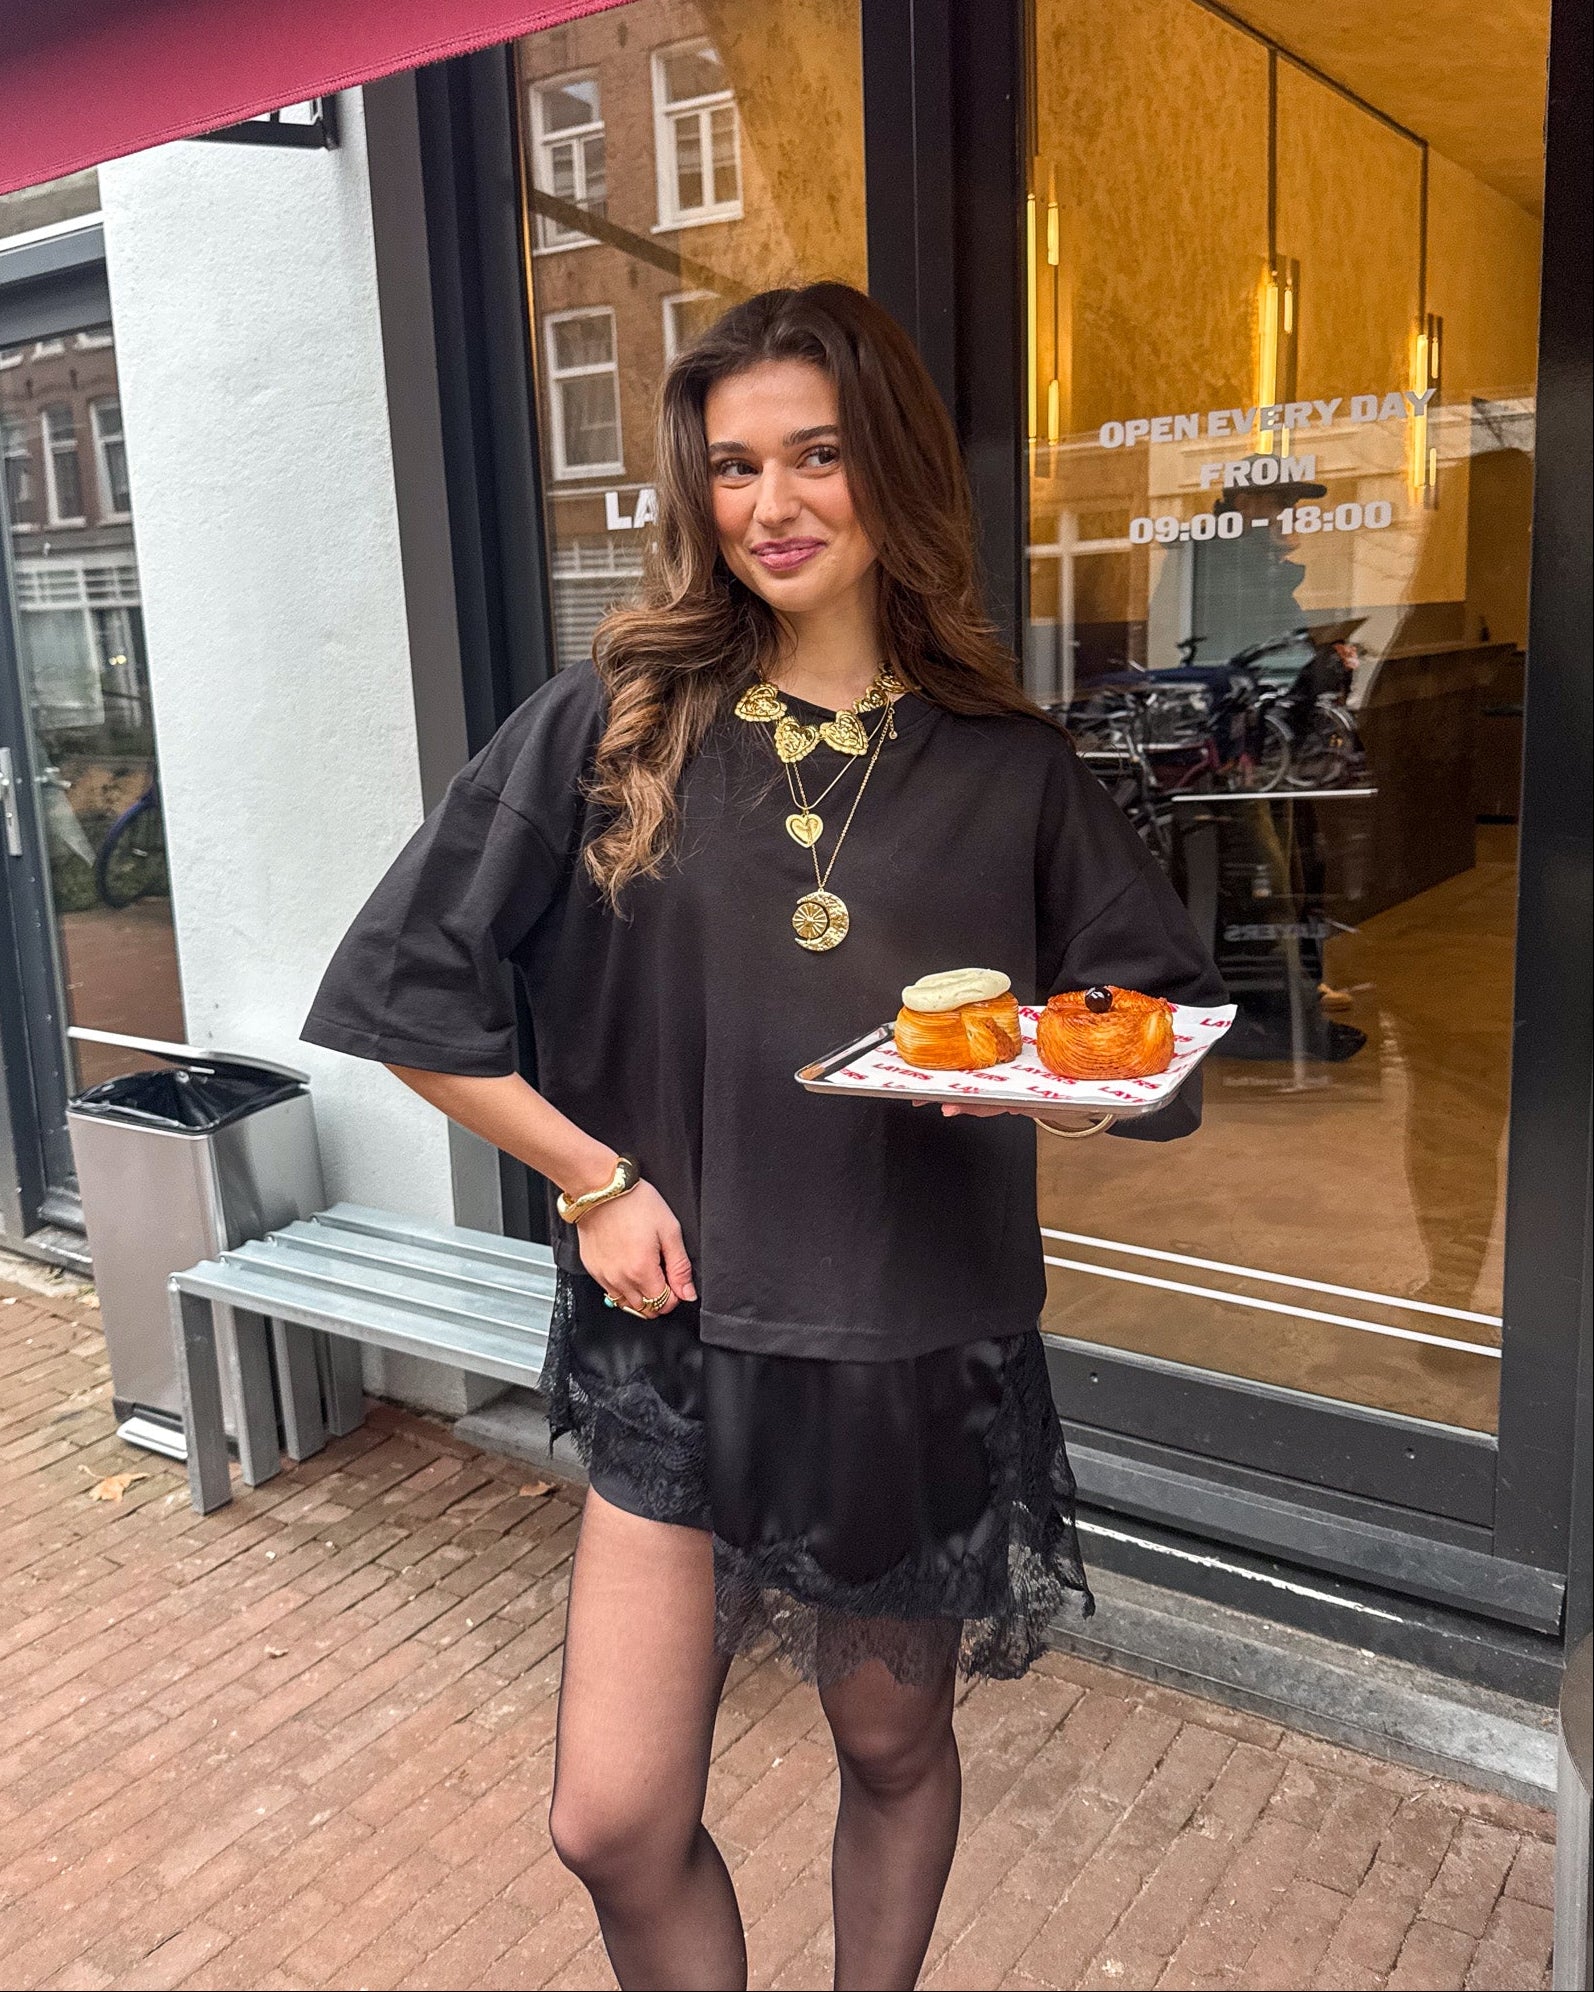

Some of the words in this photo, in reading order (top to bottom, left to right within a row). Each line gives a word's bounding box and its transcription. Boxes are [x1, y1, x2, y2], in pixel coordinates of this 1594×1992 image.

[1099, 412, 1199, 449] OPEN
[1207, 398, 1342, 438] EVERY
[1350, 388, 1437, 423] DAY
[1200, 454, 1316, 490] FROM
[1129, 511, 1244, 545] 09:00
[1276, 501, 1392, 536] 18:00
